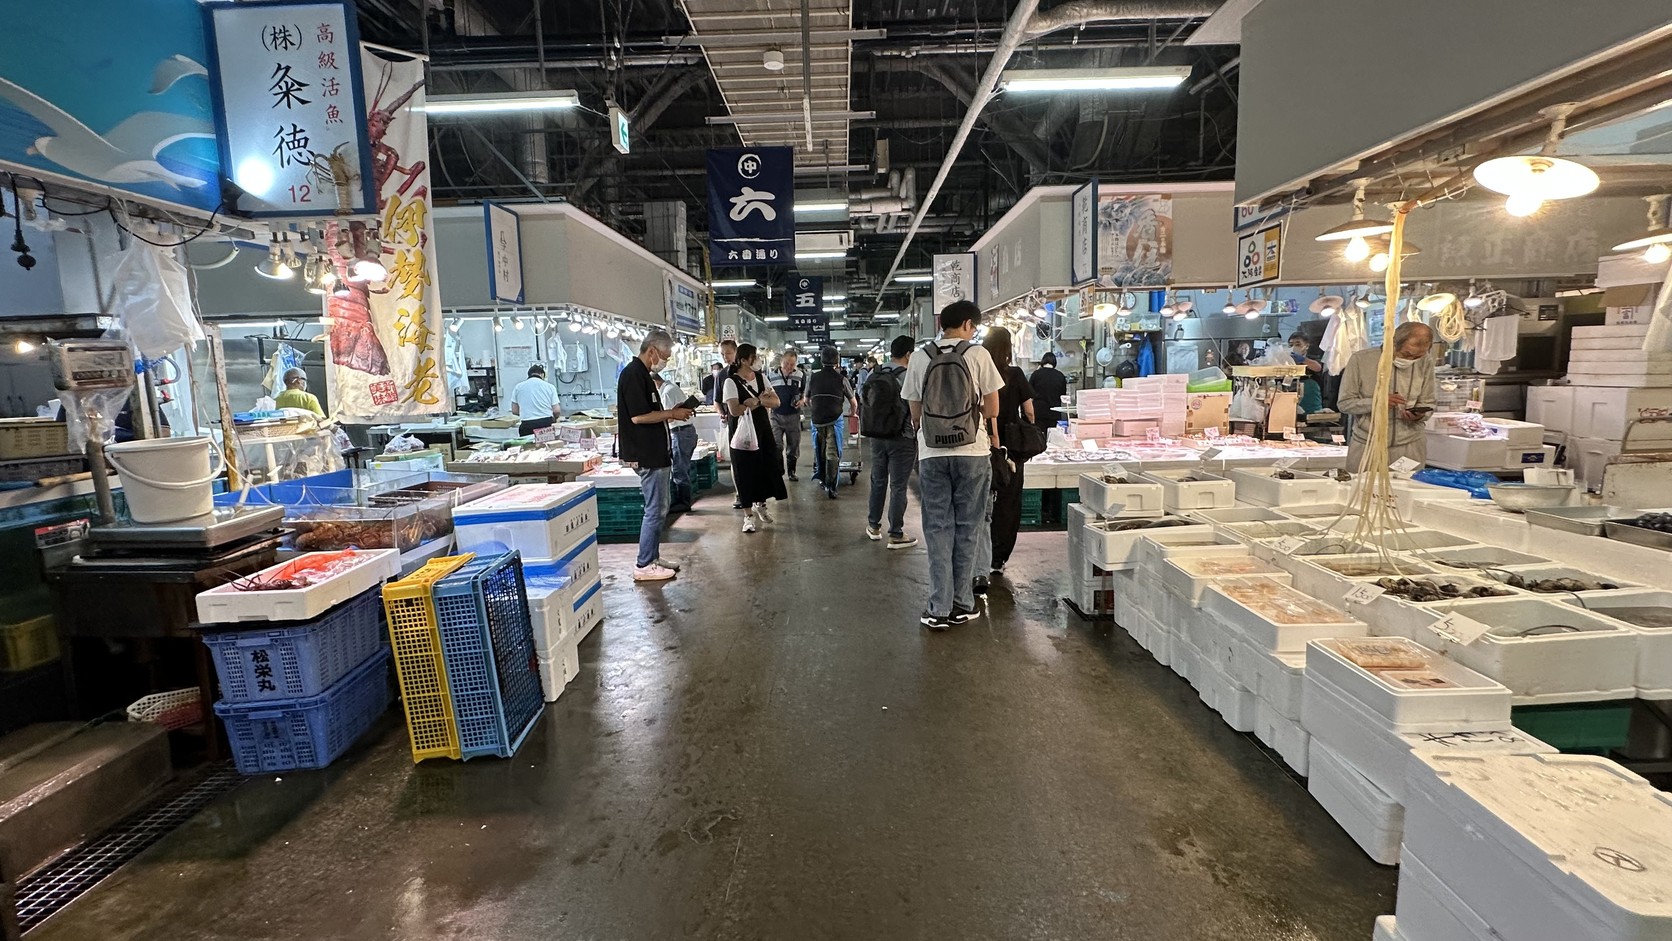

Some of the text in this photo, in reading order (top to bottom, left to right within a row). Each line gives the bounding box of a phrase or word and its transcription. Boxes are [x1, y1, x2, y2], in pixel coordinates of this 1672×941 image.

[316, 22, 344, 125] 高級活魚
[288, 184, 311, 203] 12
[729, 186, 776, 221] 六
[728, 249, 778, 260] 六番通り
[383, 194, 440, 405] 伊勢海老
[795, 292, 816, 308] 五
[935, 432, 965, 445] PUMA
[251, 649, 276, 692] 松栄丸
